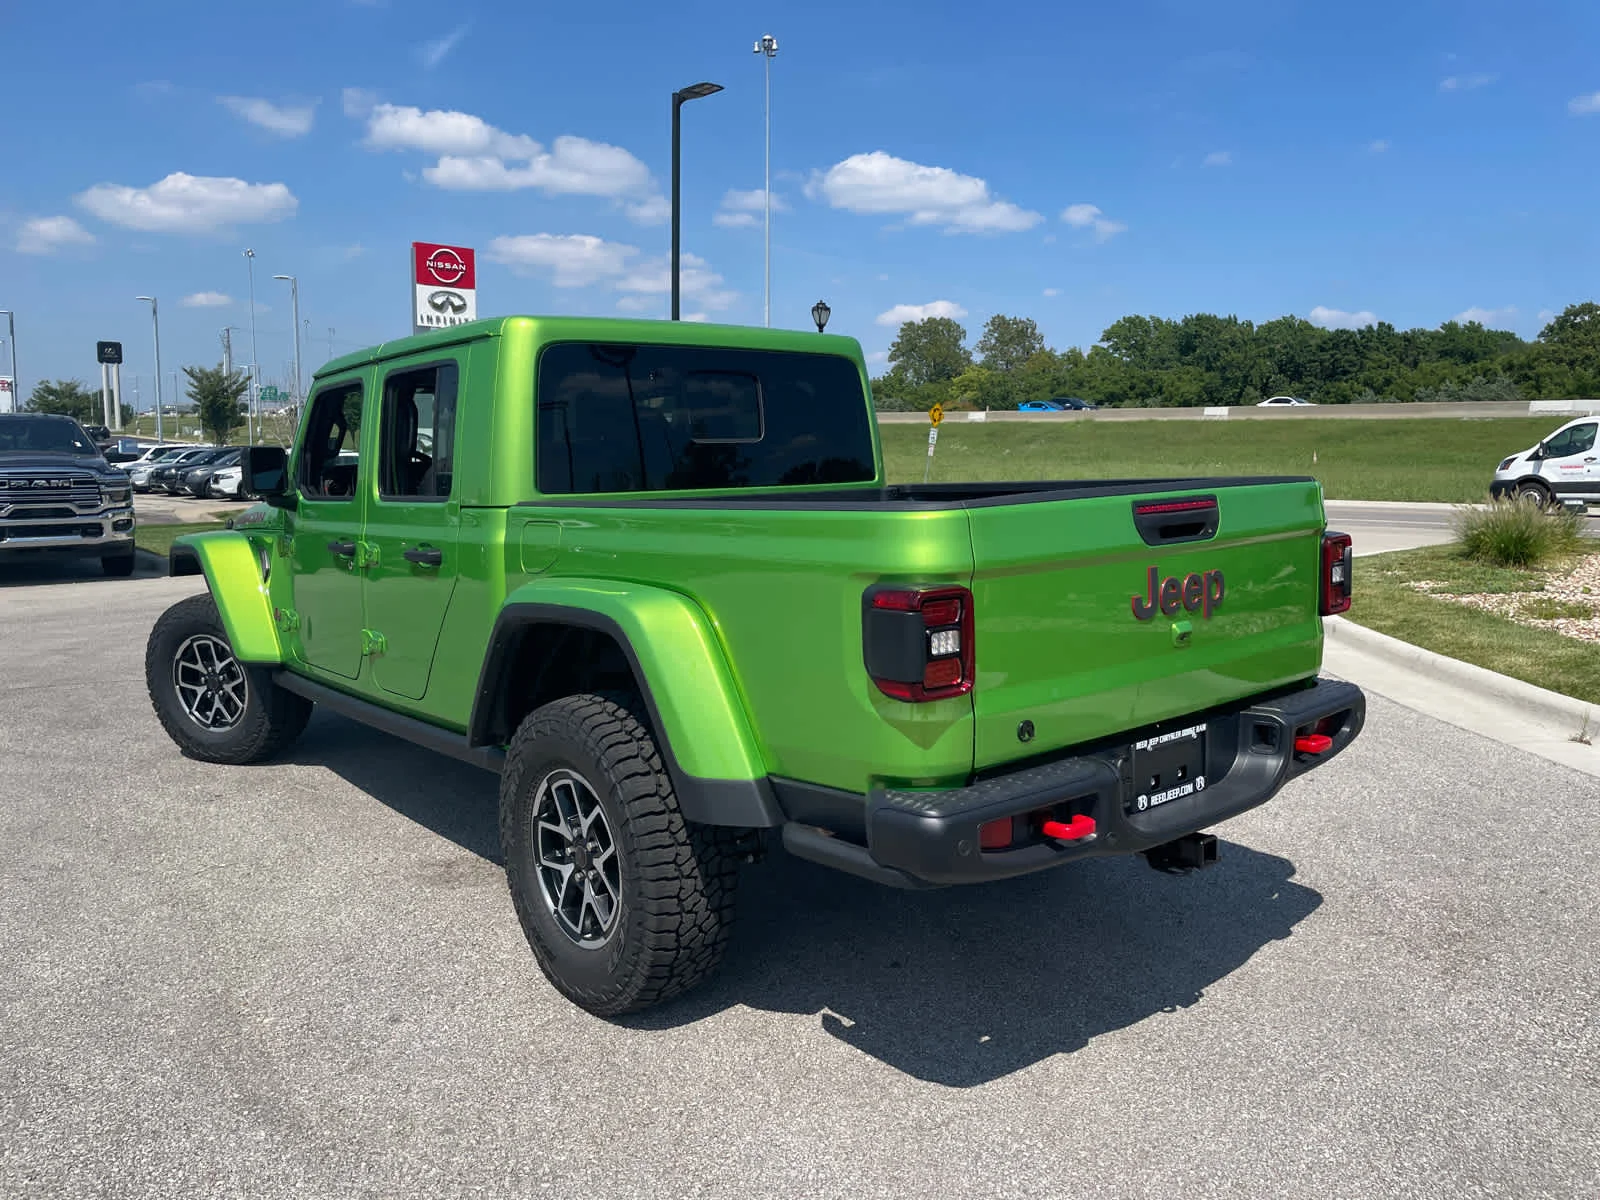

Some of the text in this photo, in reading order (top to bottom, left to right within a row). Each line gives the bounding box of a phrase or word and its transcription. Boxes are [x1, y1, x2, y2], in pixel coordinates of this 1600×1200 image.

[426, 260, 466, 270] NISSAN
[420, 313, 474, 326] INFINIT
[9, 479, 70, 488] RAM
[1131, 565, 1225, 620] Jeep
[1136, 740, 1148, 750] REED
[1148, 737, 1159, 747] JEEP
[1160, 731, 1181, 743] CHRYSLER
[1196, 722, 1207, 733] RAM
[1151, 783, 1193, 806] REEDJEEP.COM
